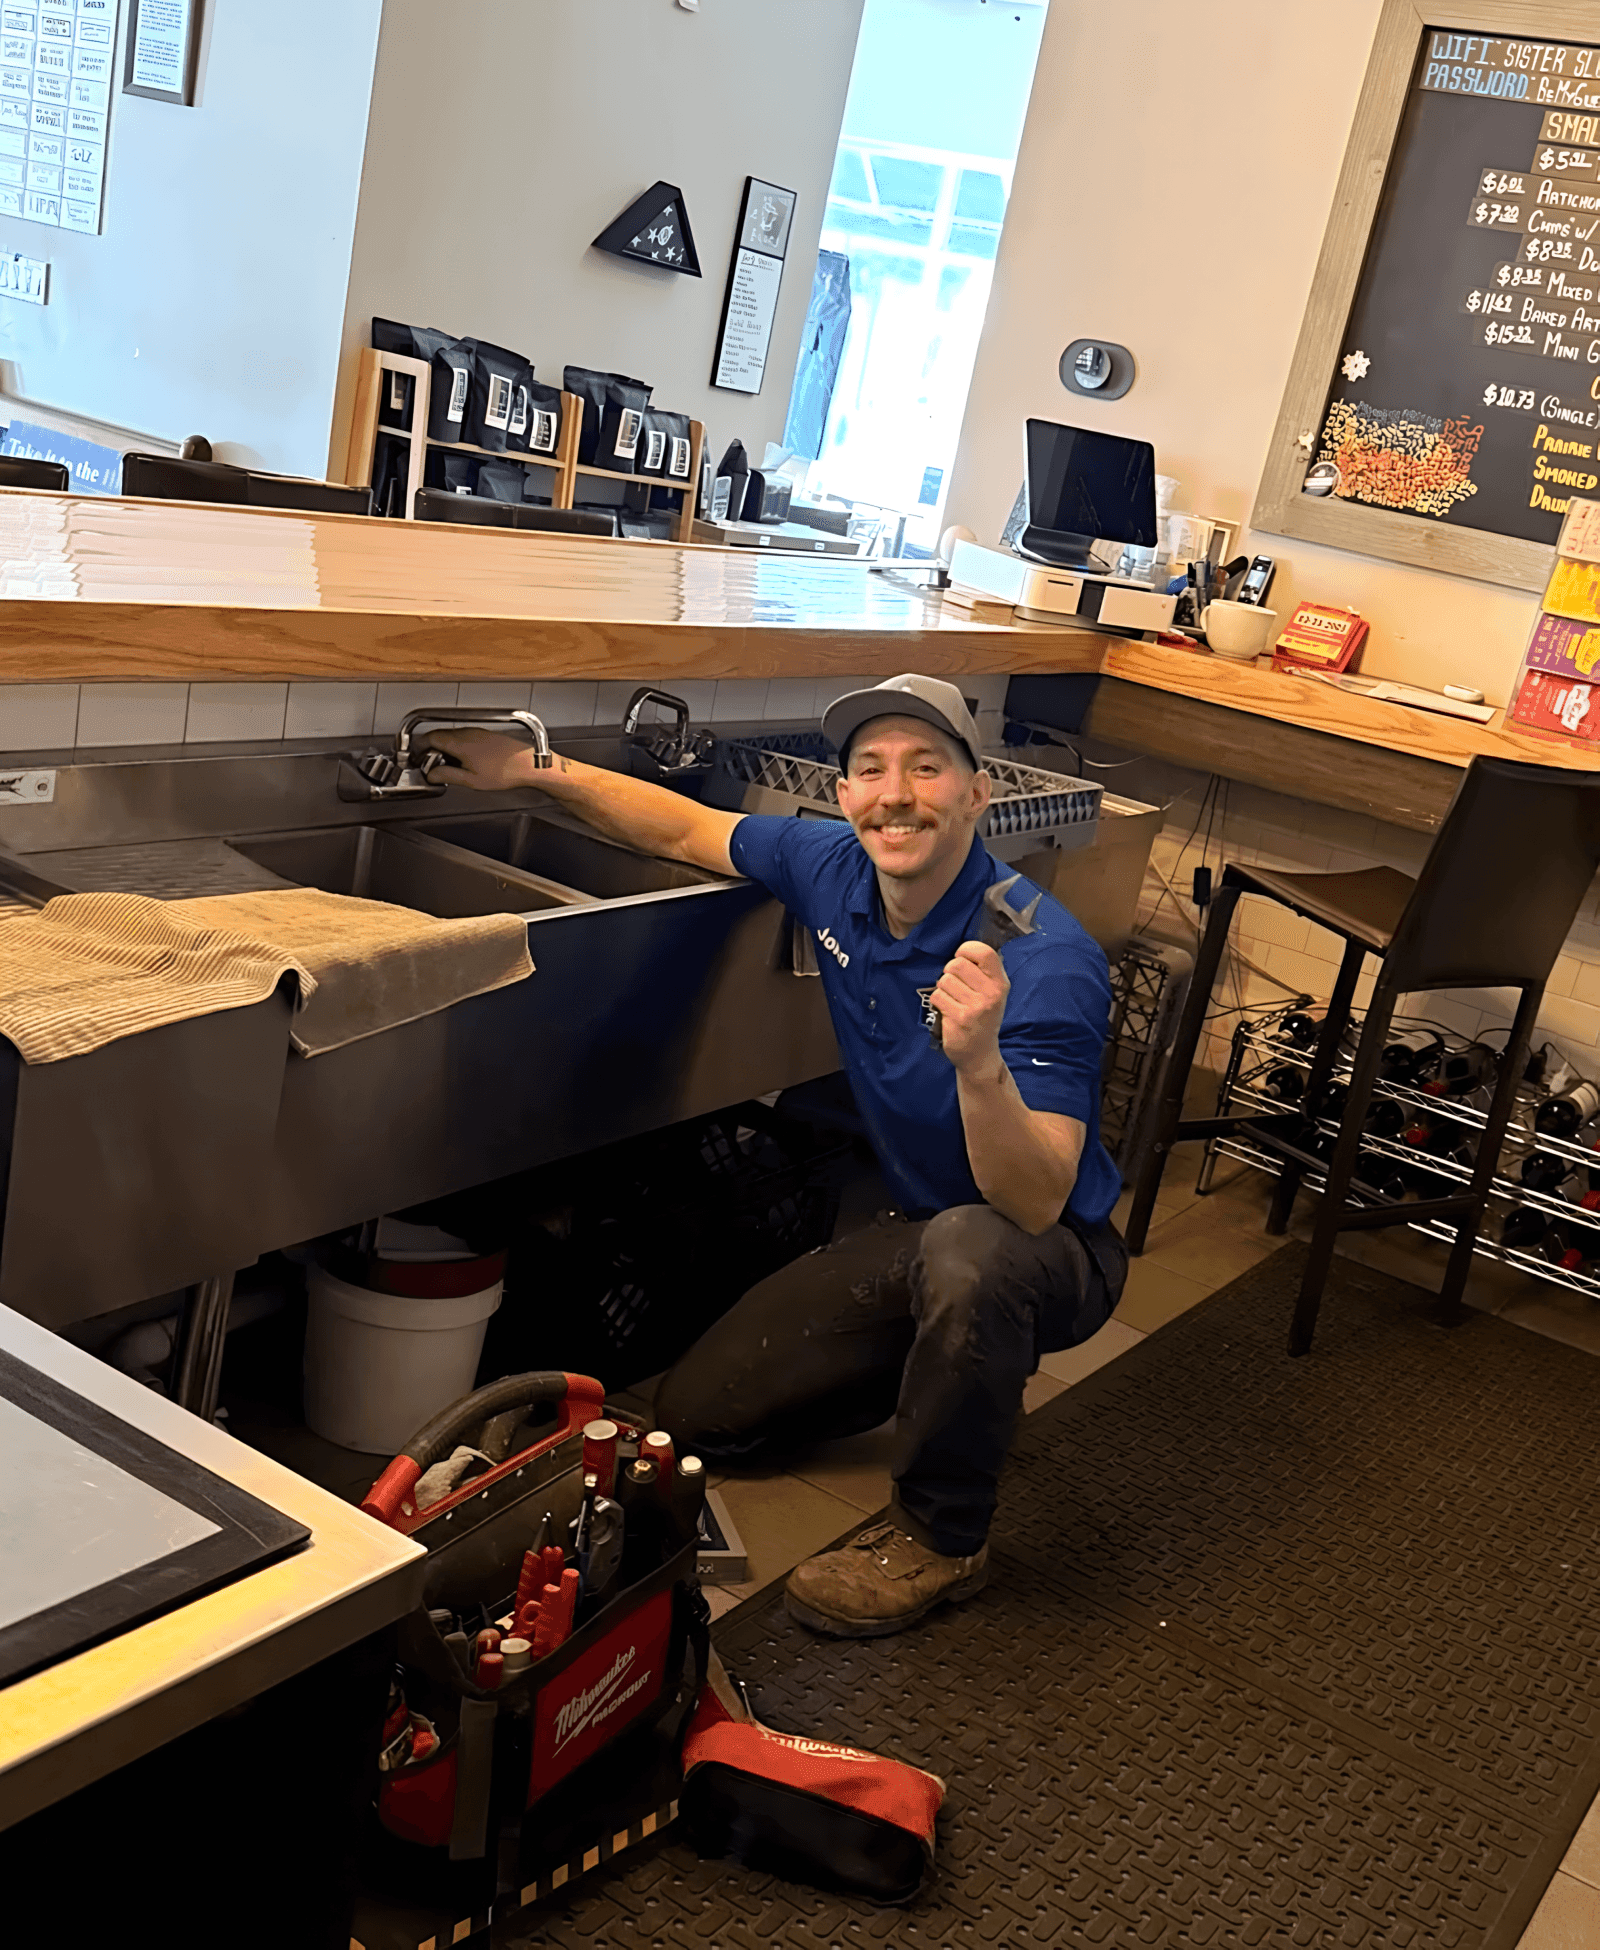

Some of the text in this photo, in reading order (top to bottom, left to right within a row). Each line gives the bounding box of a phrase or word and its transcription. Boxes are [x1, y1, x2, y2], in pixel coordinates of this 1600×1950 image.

[1504, 43, 1567, 73] SISTER
[1543, 331, 1579, 360] MINI
[75, 461, 99, 482] the
